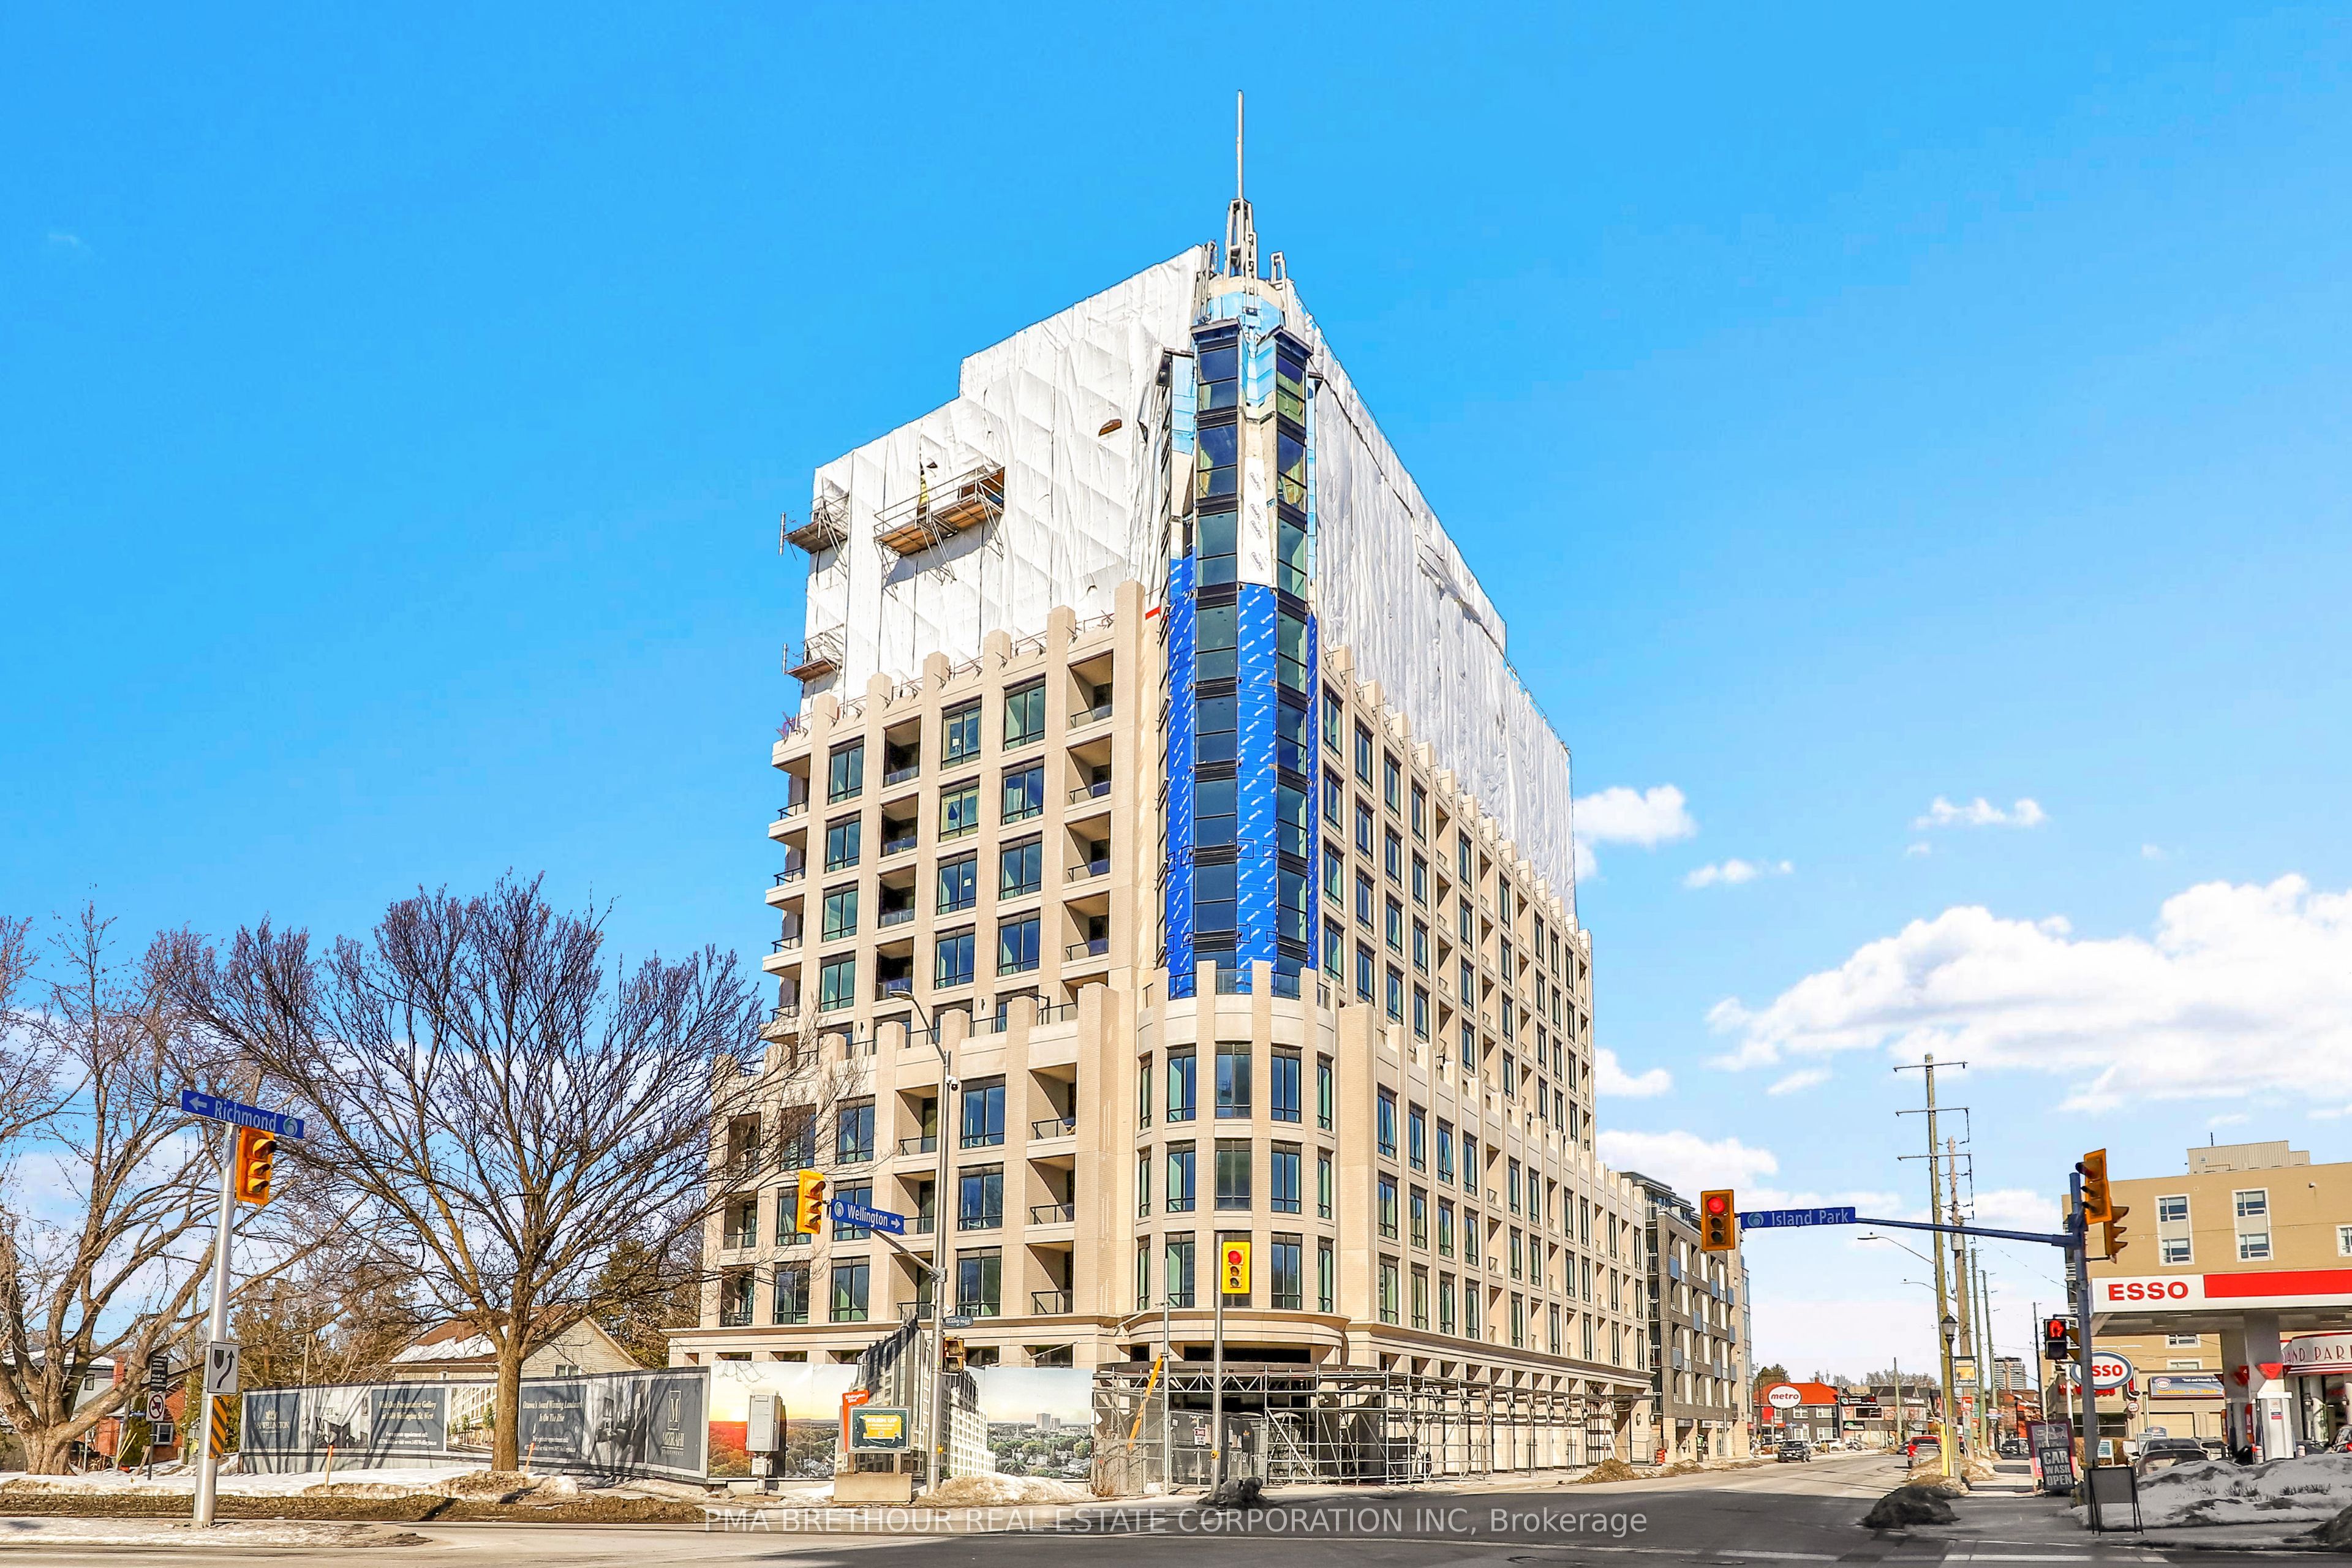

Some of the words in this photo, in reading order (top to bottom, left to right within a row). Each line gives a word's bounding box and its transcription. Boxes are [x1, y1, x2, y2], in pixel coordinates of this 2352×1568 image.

[215, 1100, 276, 1131] Richmond
[847, 1204, 888, 1227] Wellington
[1772, 1210, 1812, 1226] Island
[1819, 1208, 1849, 1224] Park
[2108, 1281, 2188, 1301] ESSO
[2091, 1365, 2124, 1377] SSO
[669, 1398, 679, 1422] M
[2043, 1450, 2069, 1464] CAR
[2045, 1464, 2071, 1474] WASH
[2046, 1474, 2073, 1485] OPEN
